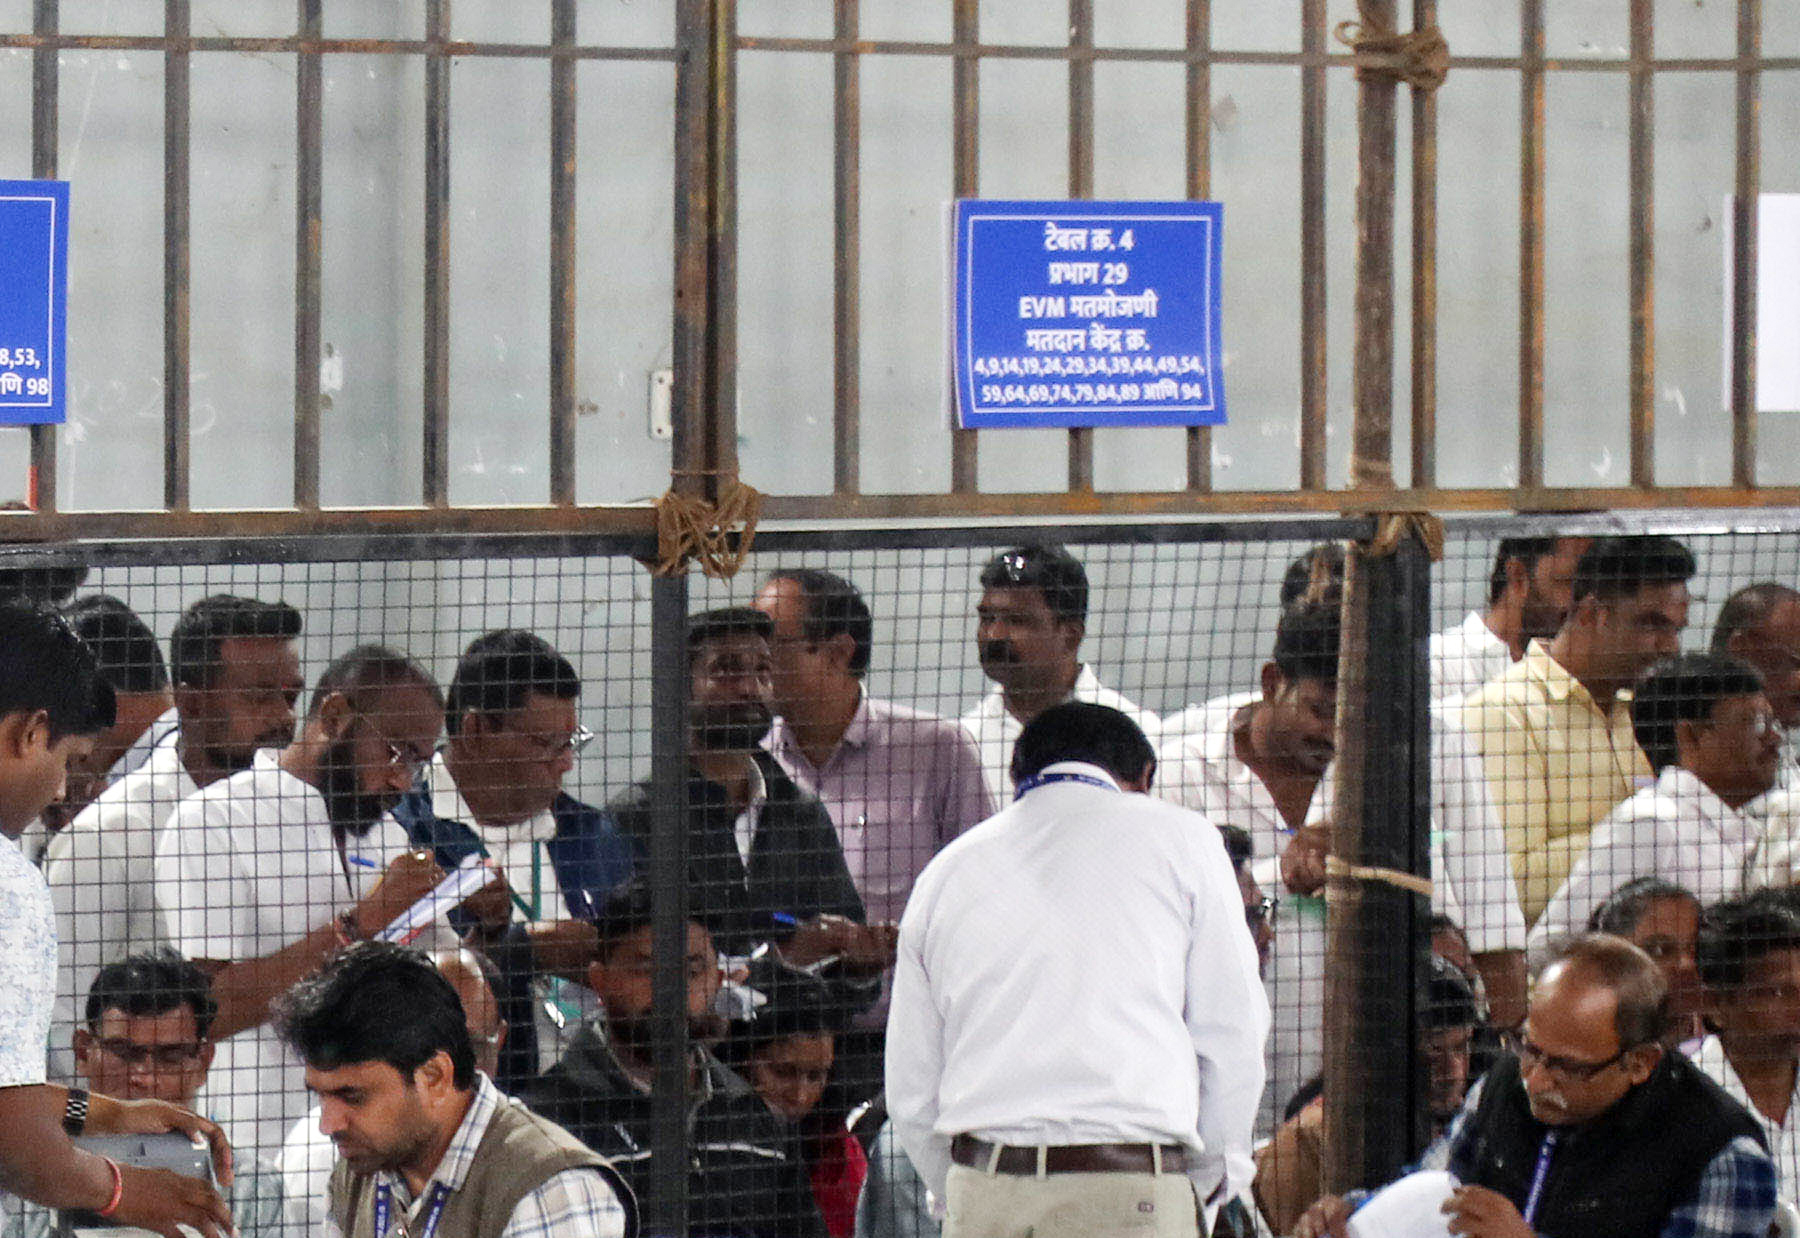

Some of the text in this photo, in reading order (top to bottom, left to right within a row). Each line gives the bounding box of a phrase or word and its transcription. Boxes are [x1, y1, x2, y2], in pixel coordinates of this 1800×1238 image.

[1118, 229, 1135, 251] 4
[1102, 262, 1129, 285] 29
[1019, 296, 1066, 319] EVM
[26, 377, 50, 396] 98
[1180, 382, 1203, 401] 94
